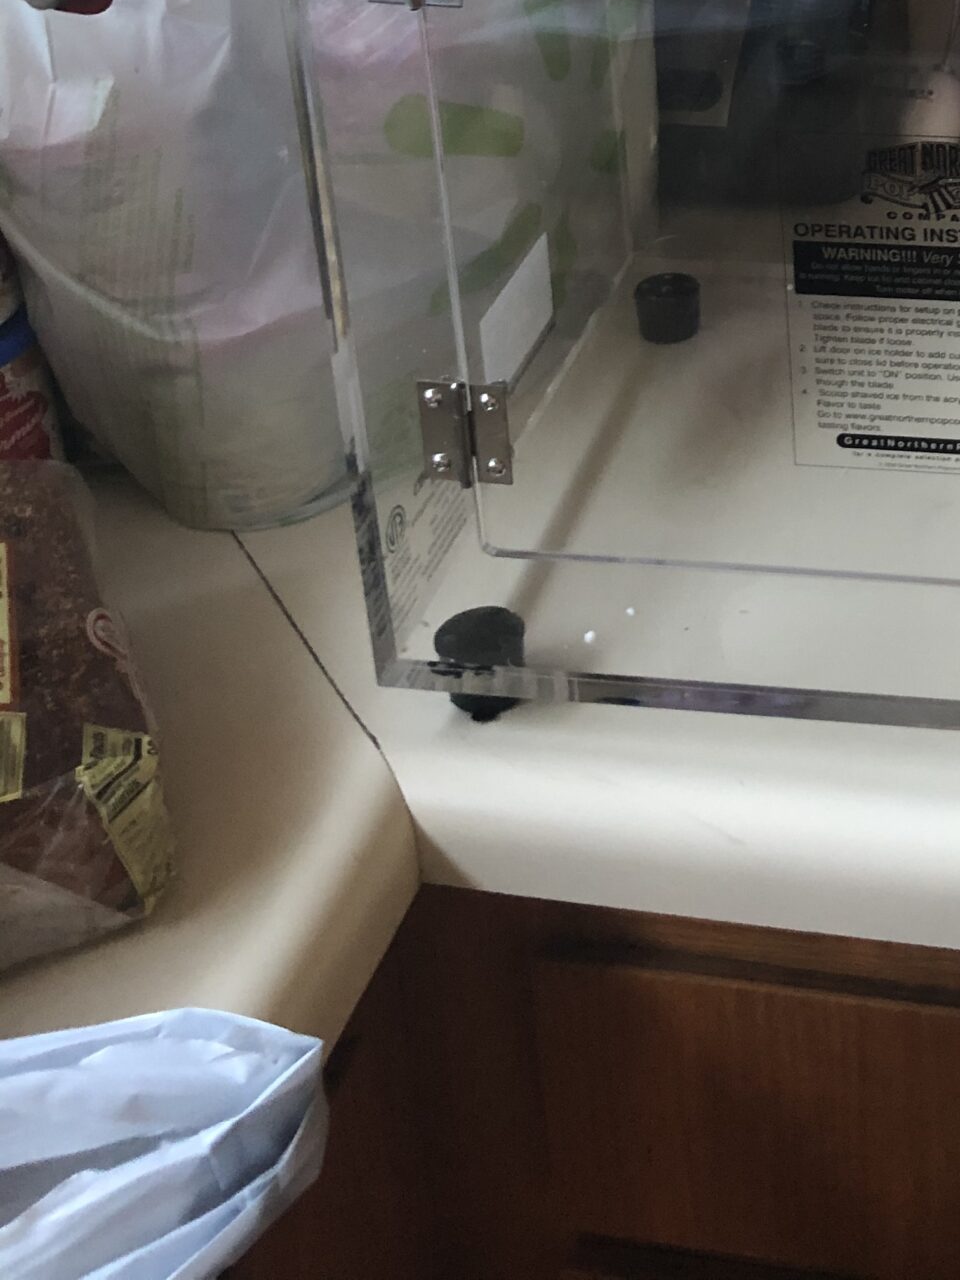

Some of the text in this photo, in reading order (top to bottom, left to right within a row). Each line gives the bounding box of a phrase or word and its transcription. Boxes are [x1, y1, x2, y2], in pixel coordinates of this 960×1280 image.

[867, 145, 917, 174] GREAT
[866, 178, 915, 200] POP
[793, 222, 916, 242] OPERATING
[822, 247, 917, 263] WARNING!!!
[922, 252, 953, 267] Very
[914, 306, 940, 315] setup
[905, 328, 944, 338] properly
[814, 334, 848, 344] Tighten
[850, 336, 876, 344] blade
[830, 346, 851, 354] door
[884, 348, 913, 356] holder
[928, 351, 946, 359] add
[876, 358, 888, 366] lid
[889, 360, 919, 368] before
[815, 367, 845, 375] Switch
[867, 370, 876, 378] to
[850, 380, 864, 388] the
[818, 389, 848, 398] Scoop
[851, 391, 884, 399] shaved
[902, 393, 924, 402] from
[925, 394, 940, 402] the
[817, 399, 845, 408] Flavor
[818, 422, 848, 431] tasting
